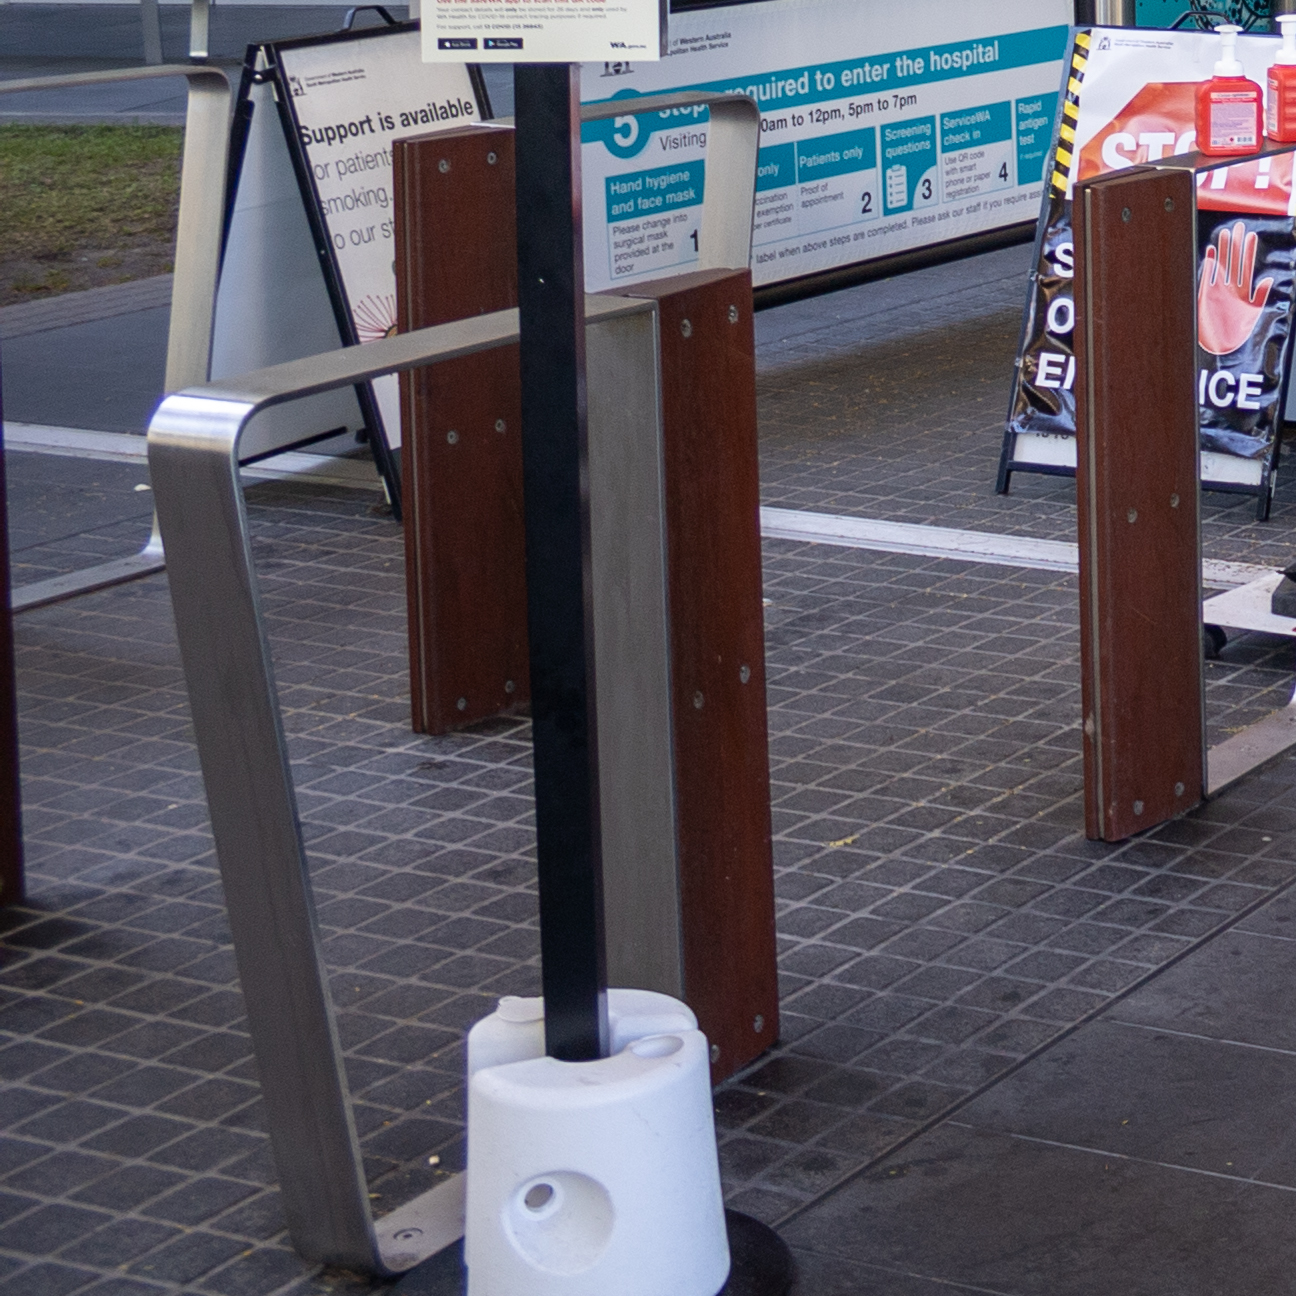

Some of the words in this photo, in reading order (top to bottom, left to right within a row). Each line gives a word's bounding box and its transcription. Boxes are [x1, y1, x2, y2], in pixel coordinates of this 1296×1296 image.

[613, 115, 639, 148] 5
[814, 70, 835, 91] to
[841, 63, 890, 88] enter
[895, 55, 925, 78] the
[929, 41, 1000, 72] hospital
[1018, 101, 1042, 115] Rapid
[301, 116, 375, 147] Support
[379, 112, 395, 132] is
[400, 98, 474, 128] available
[659, 132, 707, 151] Visiting
[761, 119, 788, 132] 0am
[792, 114, 804, 127] to
[808, 108, 845, 124] 12pm,
[848, 103, 874, 118] 5pm
[877, 99, 889, 111] to
[892, 94, 917, 110] 7pm
[943, 110, 991, 129] ServiceWA
[1019, 116, 1048, 131] antigen
[885, 123, 931, 141] Screening
[944, 131, 970, 145] check
[972, 129, 981, 139] in
[1019, 134, 1035, 146] test
[800, 151, 840, 168] Patients
[843, 146, 863, 159] only
[886, 140, 931, 159] questions
[944, 156, 957, 166] Use
[958, 153, 969, 162] QR
[970, 150, 985, 159] code
[758, 163, 779, 177] only
[945, 168, 958, 176] with
[959, 163, 977, 173] smart
[999, 161, 1008, 182] 4
[610, 177, 642, 195] Hand
[646, 170, 690, 190] hygiene
[800, 185, 819, 196] Proof
[821, 183, 828, 192] of
[922, 179, 932, 200] 3
[945, 176, 964, 189] phone
[965, 174, 972, 183] or
[973, 172, 991, 183] paper
[320, 185, 393, 216] smoking.
[801, 192, 844, 209] appointment
[945, 185, 980, 199] registration
[611, 198, 634, 215] and
[637, 195, 662, 210] face
[666, 189, 695, 204] mask
[756, 203, 794, 218] exemption
[861, 192, 872, 214] 2
[613, 224, 640, 236] Please
[642, 217, 671, 231] change
[673, 213, 688, 223] into
[756, 249, 776, 264] label
[778, 246, 800, 258] when
[802, 239, 827, 253] above
[829, 235, 850, 247] steps
[853, 231, 865, 241] are
[867, 220, 909, 238] completed.
[911, 215, 936, 227] Please
[938, 210, 950, 221] ask
[952, 208, 964, 218] our
[966, 203, 982, 214] staff
[983, 201, 989, 210] if
[989, 198, 1002, 210] you
[1003, 193, 1027, 206] require
[350, 224, 377, 246] our
[614, 236, 645, 250] surgical
[647, 231, 668, 241] mask
[690, 229, 698, 252] 1
[615, 247, 649, 263] provided
[652, 245, 660, 254] at
[661, 242, 674, 252] the
[615, 263, 634, 275] door
